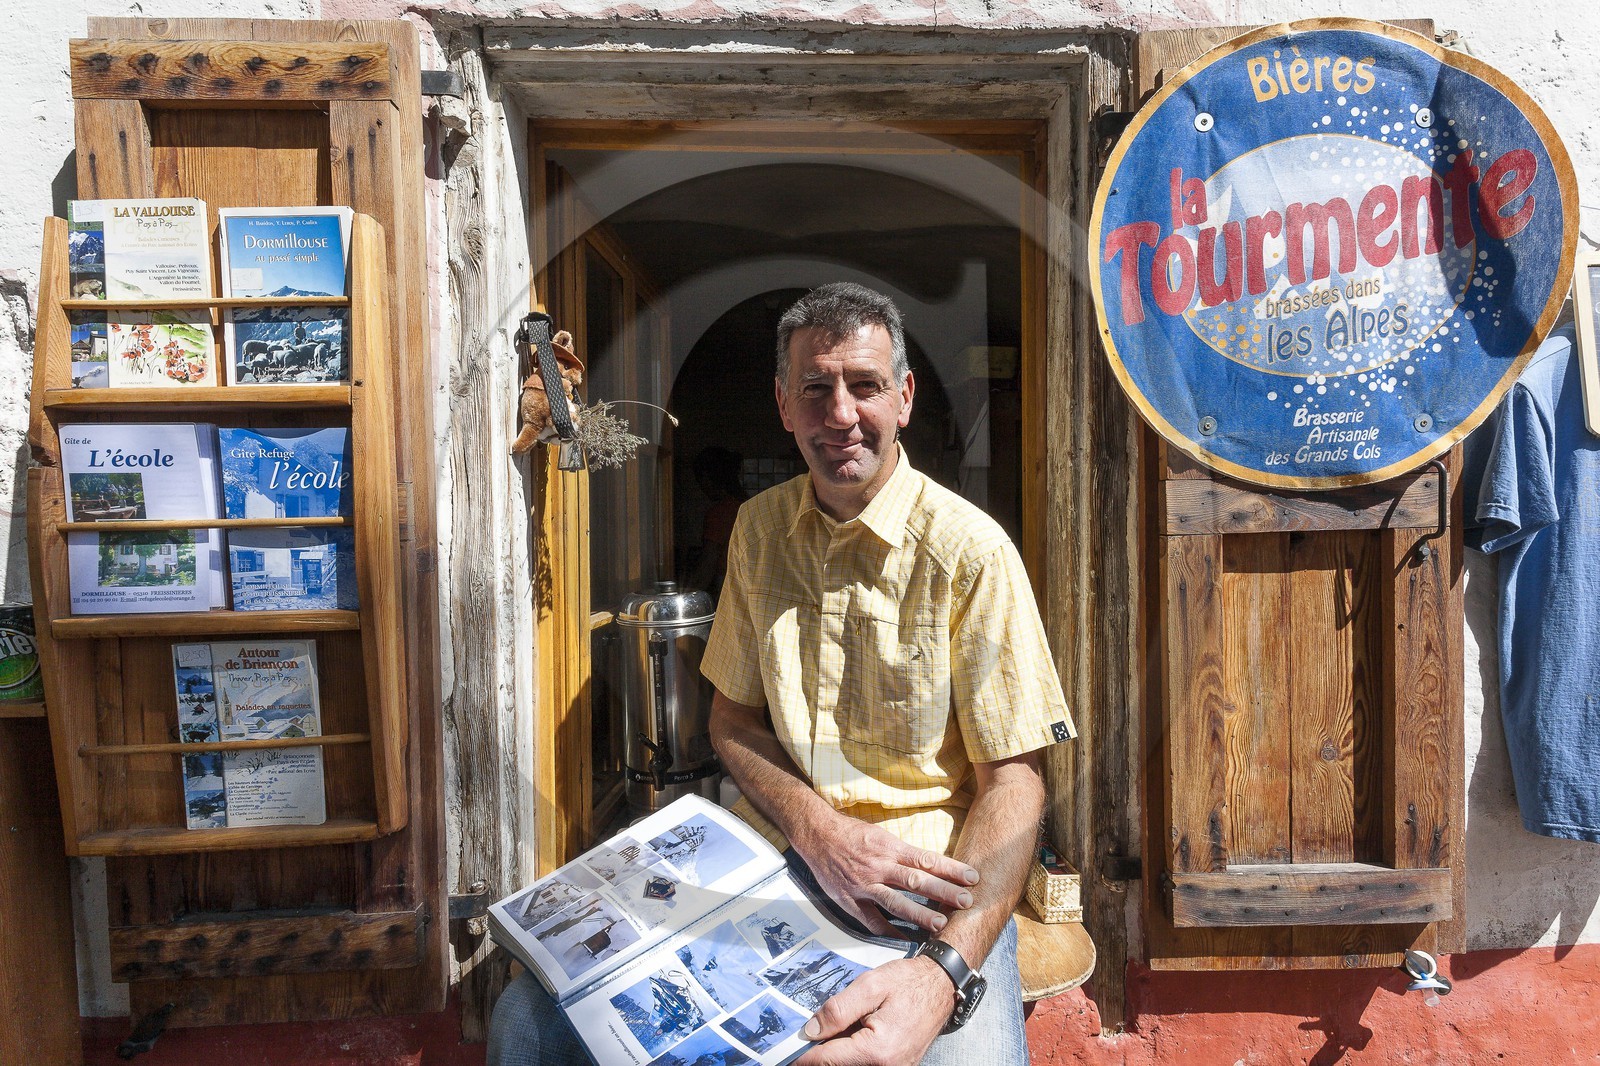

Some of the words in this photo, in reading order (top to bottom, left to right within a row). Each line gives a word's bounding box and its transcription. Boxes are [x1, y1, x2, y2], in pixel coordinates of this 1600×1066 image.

[1246, 46, 1376, 103] Bières
[1169, 167, 1209, 230] la
[113, 206, 131, 217] LA
[132, 205, 196, 217] VALLOUISE
[136, 218, 151, 229] Pas
[1104, 148, 1538, 326] Tourmente
[269, 253, 291, 264] passé
[294, 252, 319, 264] simple
[1266, 285, 1340, 319] brassées
[1345, 277, 1381, 300] dans
[1266, 324, 1313, 365] les
[1324, 303, 1410, 351] Alpes
[1293, 408, 1364, 427] Brasserie
[82, 437, 92, 445] de
[1306, 426, 1380, 445] Artisanale
[88, 448, 174, 468] L'école
[259, 447, 295, 461] Refuge
[1265, 451, 1290, 466] des
[1294, 445, 1349, 465] Grands
[1353, 441, 1381, 460] Cols
[269, 460, 350, 490] l'école
[238, 647, 280, 658] Autour
[225, 659, 240, 670] de
[242, 659, 299, 672] Briançon
[278, 703, 312, 711] raquettes
